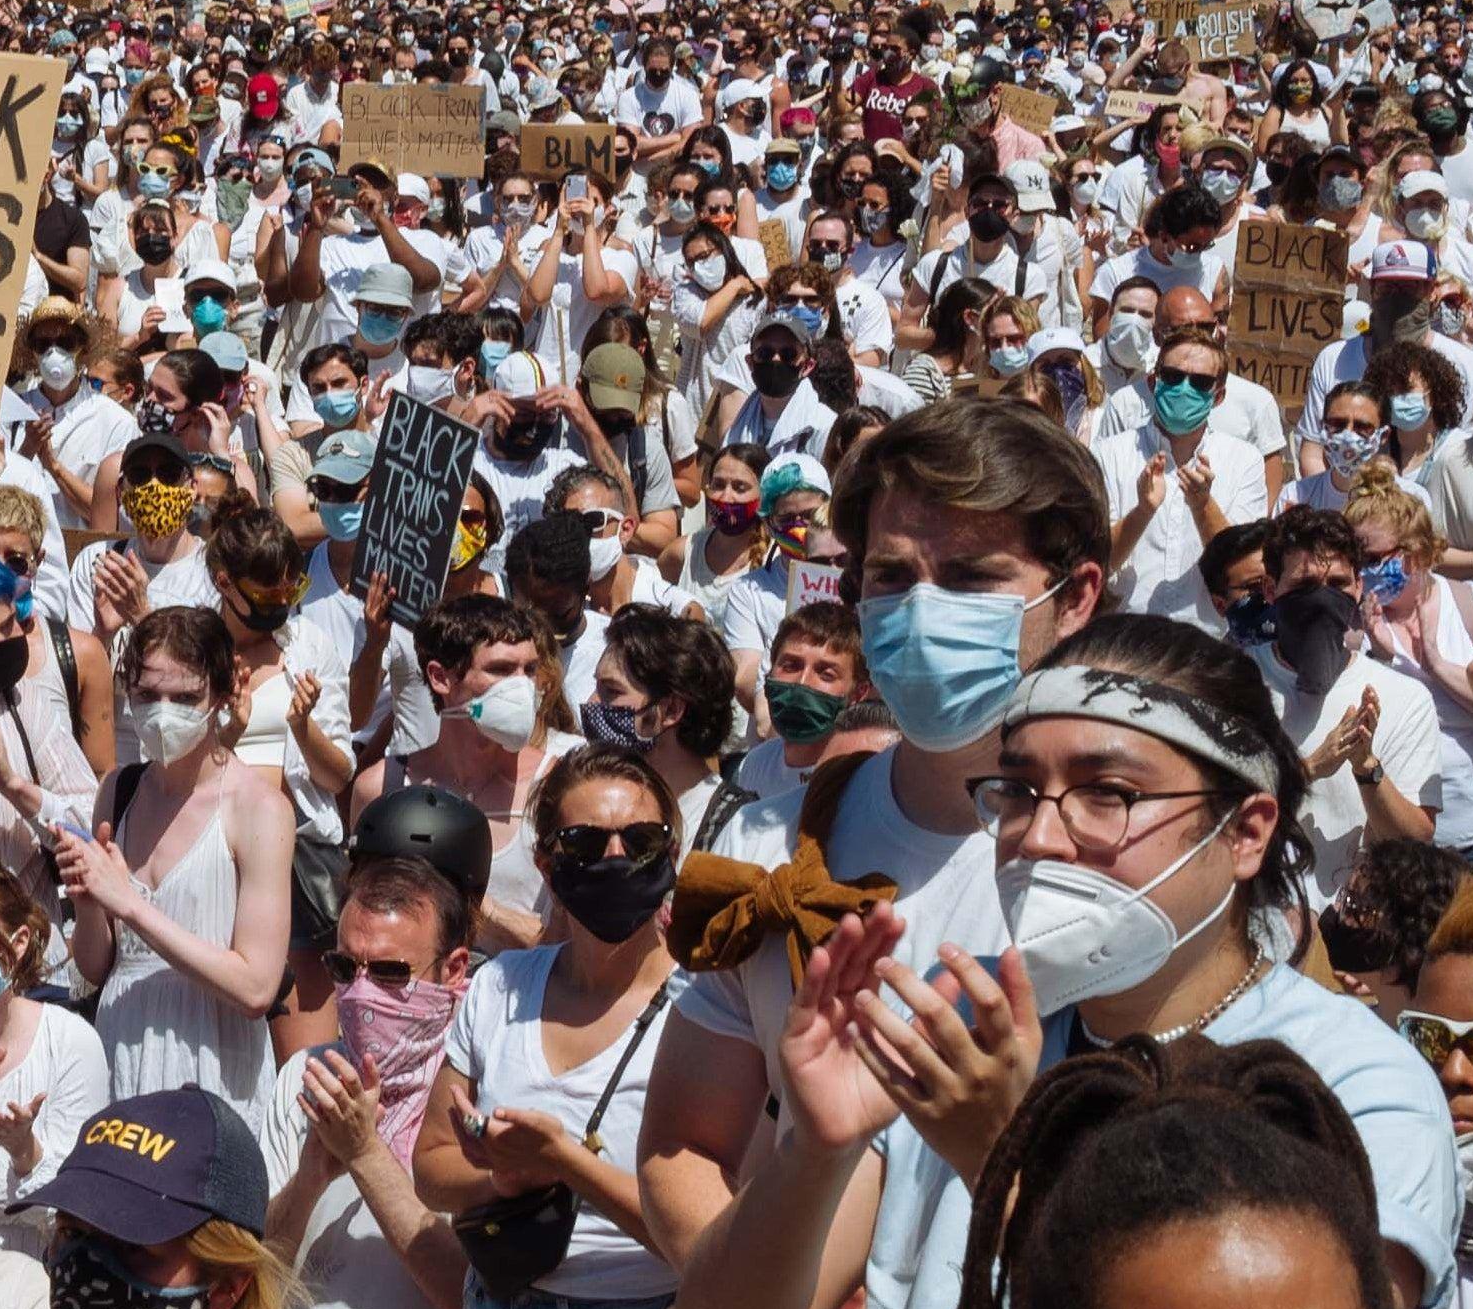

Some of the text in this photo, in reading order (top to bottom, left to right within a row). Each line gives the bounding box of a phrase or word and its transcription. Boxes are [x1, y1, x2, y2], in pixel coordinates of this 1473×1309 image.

[1196, 8, 1256, 37] BOLISH
[1199, 35, 1240, 59] ICE
[349, 93, 426, 125] BLACK
[865, 88, 912, 114] Rebe
[357, 128, 483, 157] LIVES MATTER
[544, 135, 612, 174] BLM
[1246, 223, 1343, 280] BLACK
[1248, 290, 1345, 336] LIVES
[387, 394, 476, 491] BLACK
[382, 458, 451, 538] TRANS
[367, 501, 431, 572] LIVES
[362, 542, 440, 611] MATTER
[84, 1117, 178, 1164] CREW
